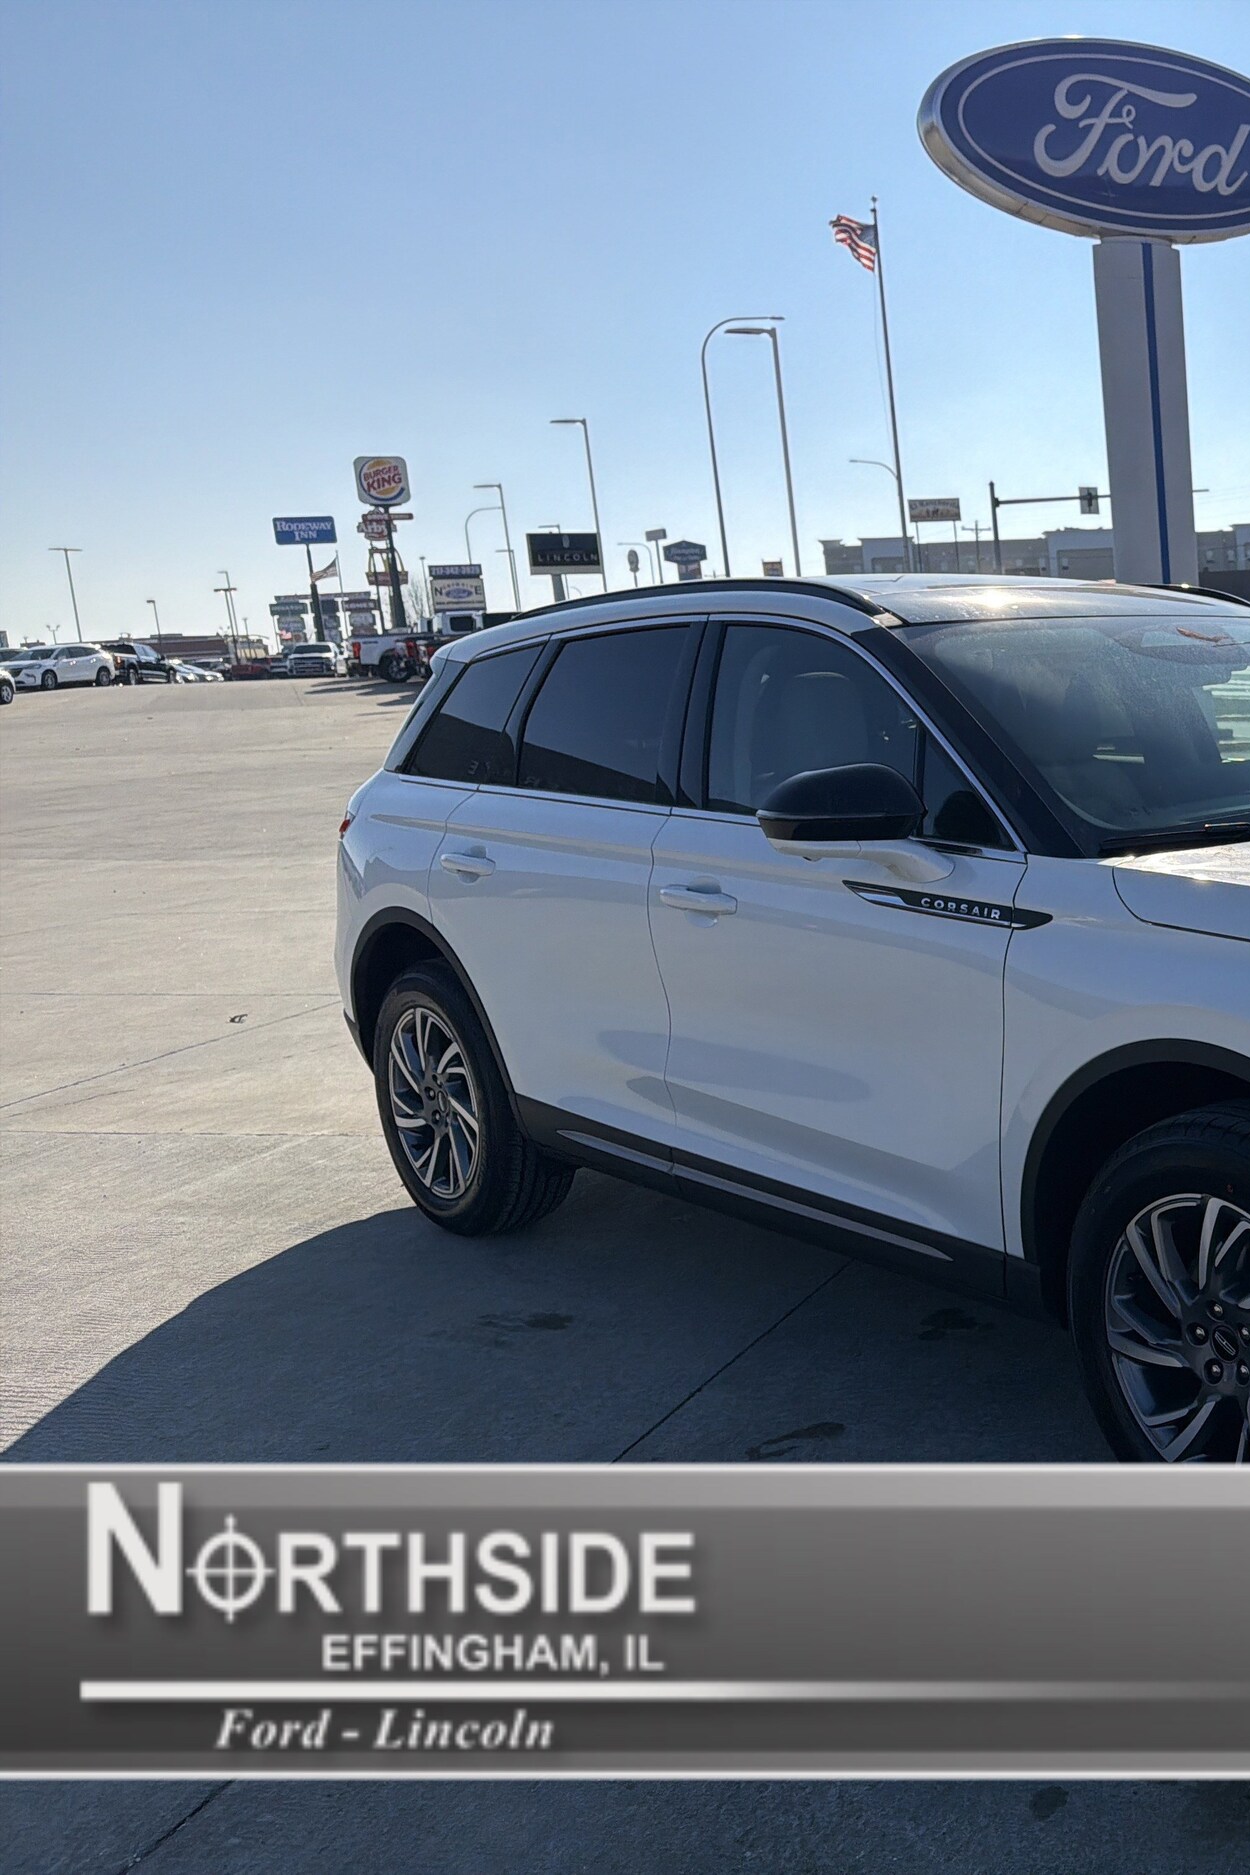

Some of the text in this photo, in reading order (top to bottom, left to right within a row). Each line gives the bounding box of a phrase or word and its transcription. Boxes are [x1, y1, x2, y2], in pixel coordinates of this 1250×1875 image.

[363, 464, 400, 481] BURGER
[366, 473, 402, 492] KING
[275, 520, 332, 531] RODEWAY
[294, 530, 317, 541] INN
[537, 552, 597, 562] LINCOLN
[920, 897, 1001, 920] CORSAIR
